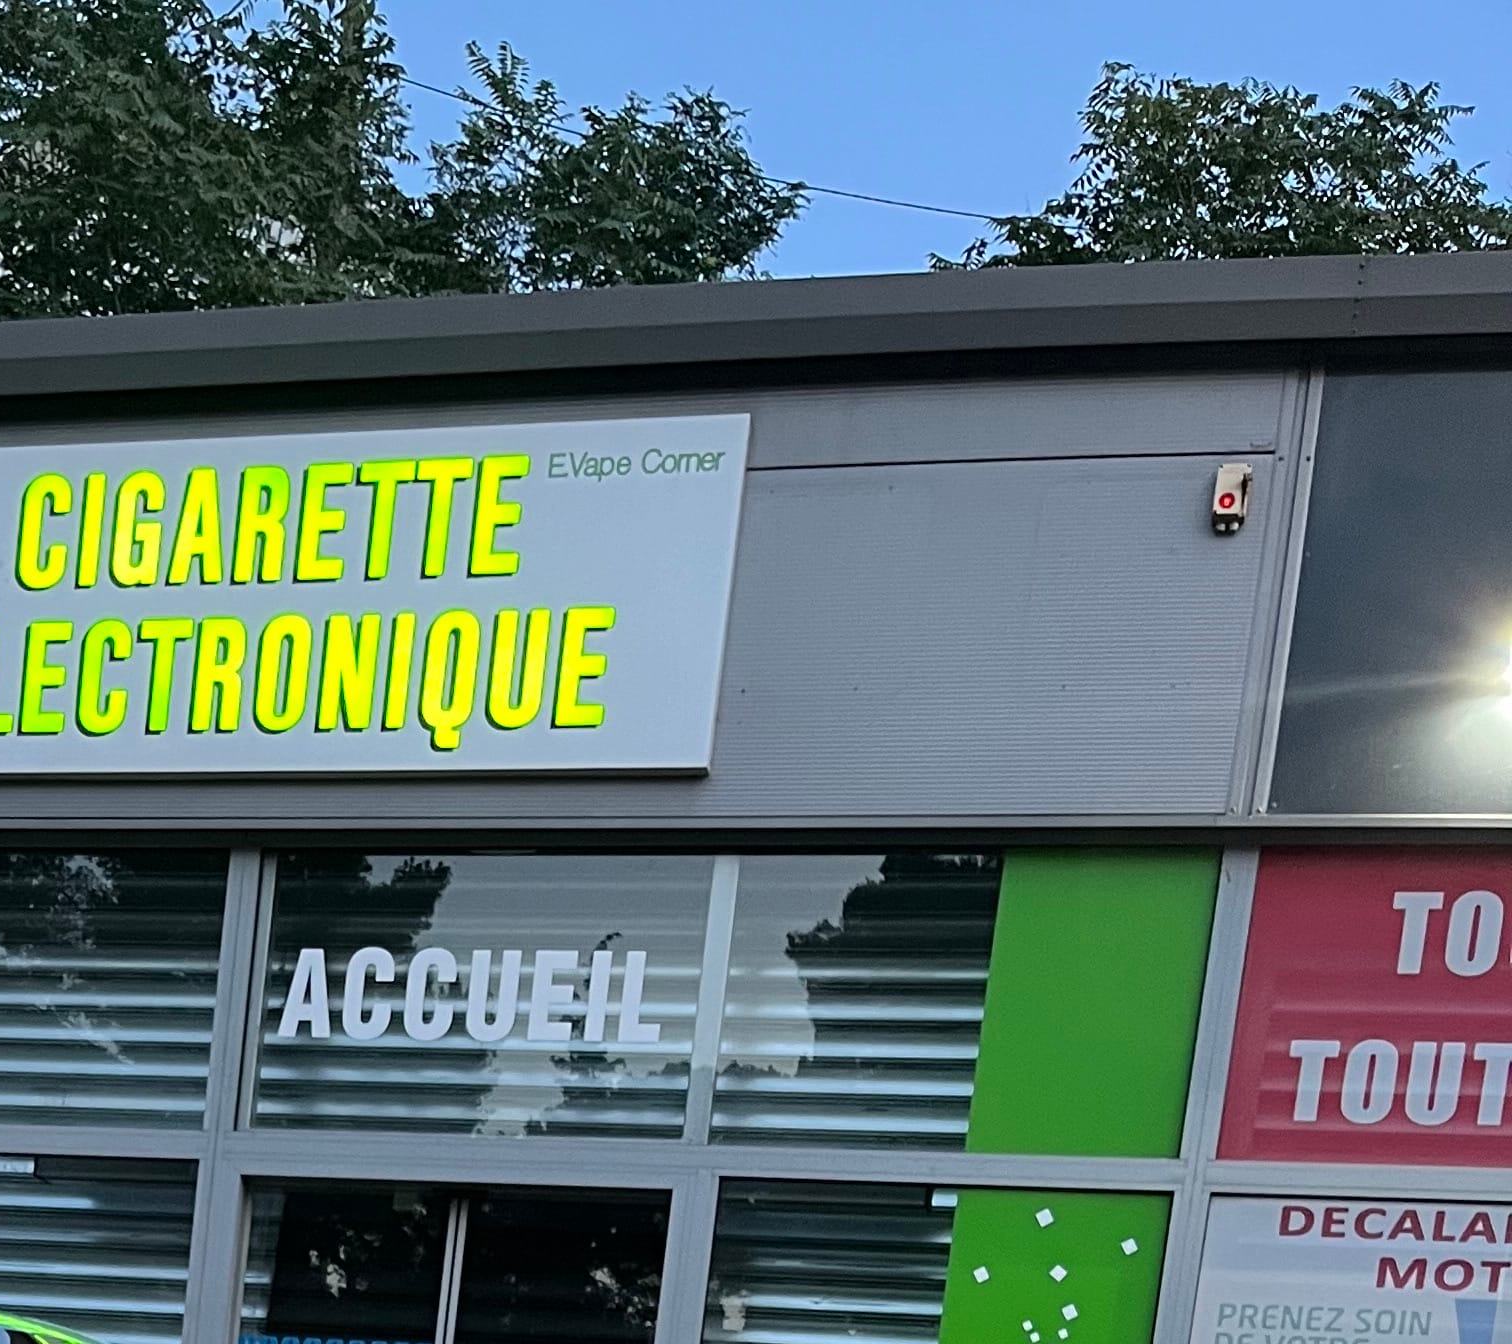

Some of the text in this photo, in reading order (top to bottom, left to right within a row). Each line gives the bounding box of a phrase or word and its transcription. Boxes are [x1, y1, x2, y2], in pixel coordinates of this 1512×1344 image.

[548, 448, 727, 482] EVape Corner
[14, 454, 531, 591] CIGARETTE
[1393, 889, 1512, 977] TO
[277, 945, 662, 1043] ACCUEIL
[1278, 1204, 1512, 1245] DECALA
[1217, 1303, 1433, 1337] PRENEZ SOIN
